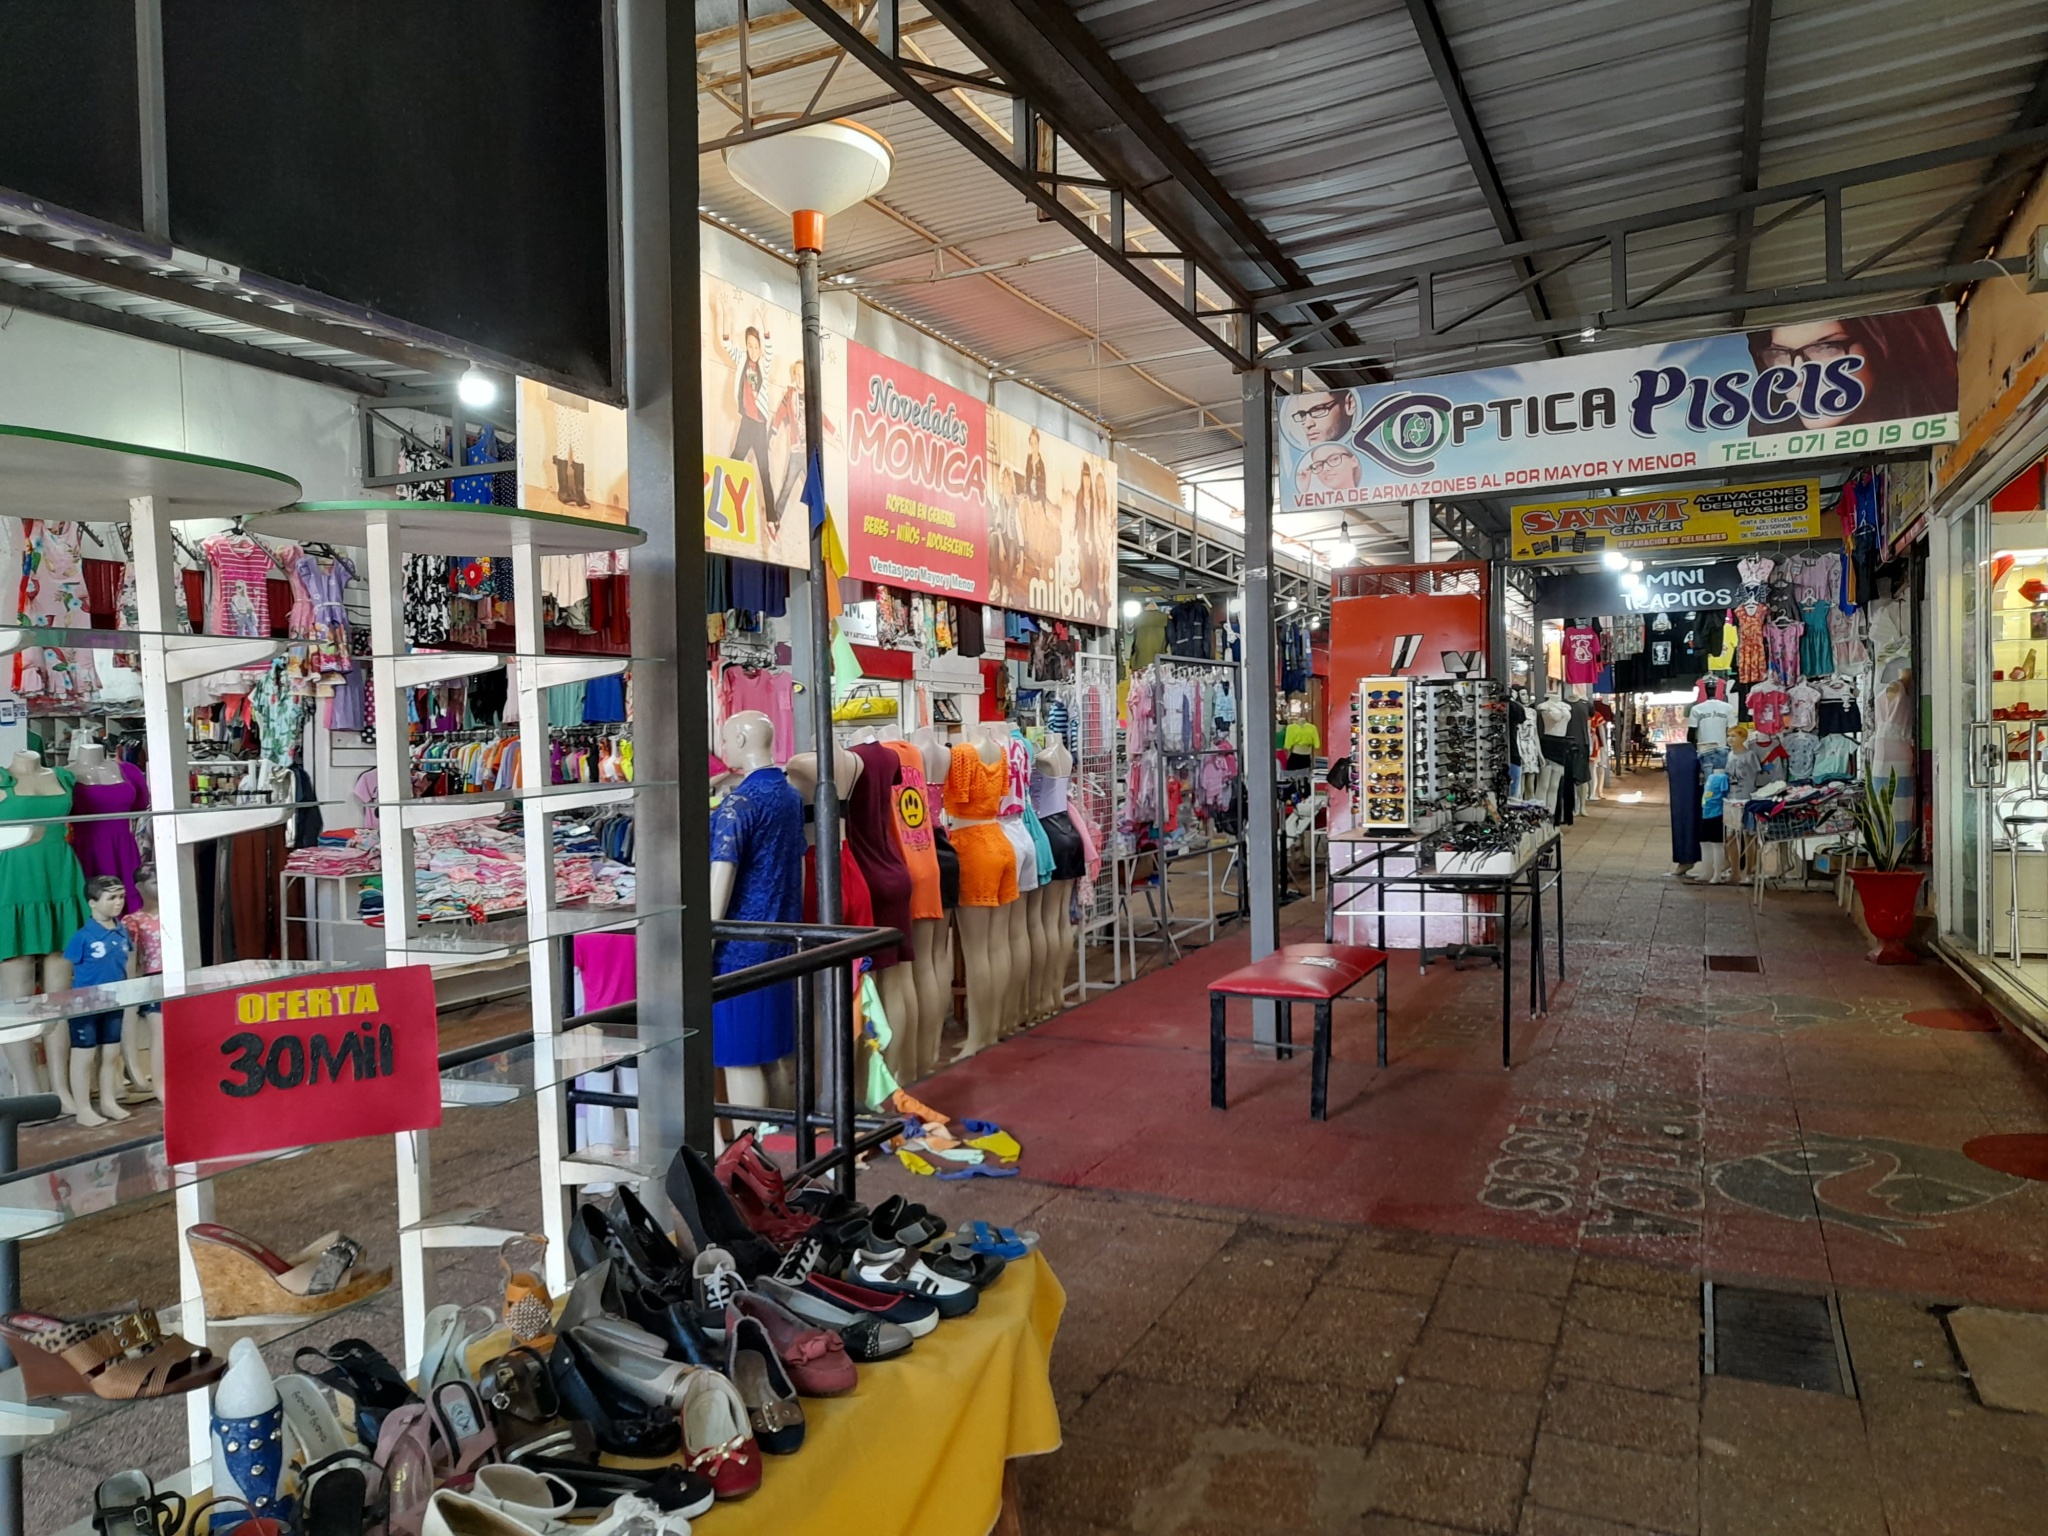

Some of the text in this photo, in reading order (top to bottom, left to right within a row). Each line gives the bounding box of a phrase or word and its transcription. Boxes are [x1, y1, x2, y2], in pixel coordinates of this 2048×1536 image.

[869, 376, 968, 446] Novedades
[1787, 432, 1824, 455] 071
[1834, 428, 1868, 449] 20
[1878, 424, 1901, 444] 19
[1912, 418, 1946, 441] 05
[849, 408, 987, 506] MONICA
[1294, 452, 1697, 507] VENTA DE ARMAZONES AL POR MAYOR Y MENOR
[1695, 486, 1806, 504] ACTIVACIONES
[704, 465, 751, 537] LY
[917, 502, 927, 521] EN
[928, 506, 956, 528] GENERAL
[1523, 500, 1689, 534] SANTI
[1701, 495, 1807, 511] DESBLOQUEO
[1735, 502, 1806, 516] FLASHEO
[863, 515, 890, 538] BEBES
[896, 521, 921, 546] NIÑOS
[926, 531, 975, 559] ADOLESCENTES
[1610, 521, 1683, 536] CENTER
[1618, 533, 1728, 549] REPARACION DE CELULARES
[1756, 523, 1792, 531] ACCESORIOS
[870, 556, 976, 593] Ventas por Mayor y Menor
[1646, 568, 1705, 588] MINI
[1620, 588, 1732, 611] TRAPITOS
[237, 984, 379, 1024] OFERTA
[1477, 1103, 1595, 1216] PISCIS
